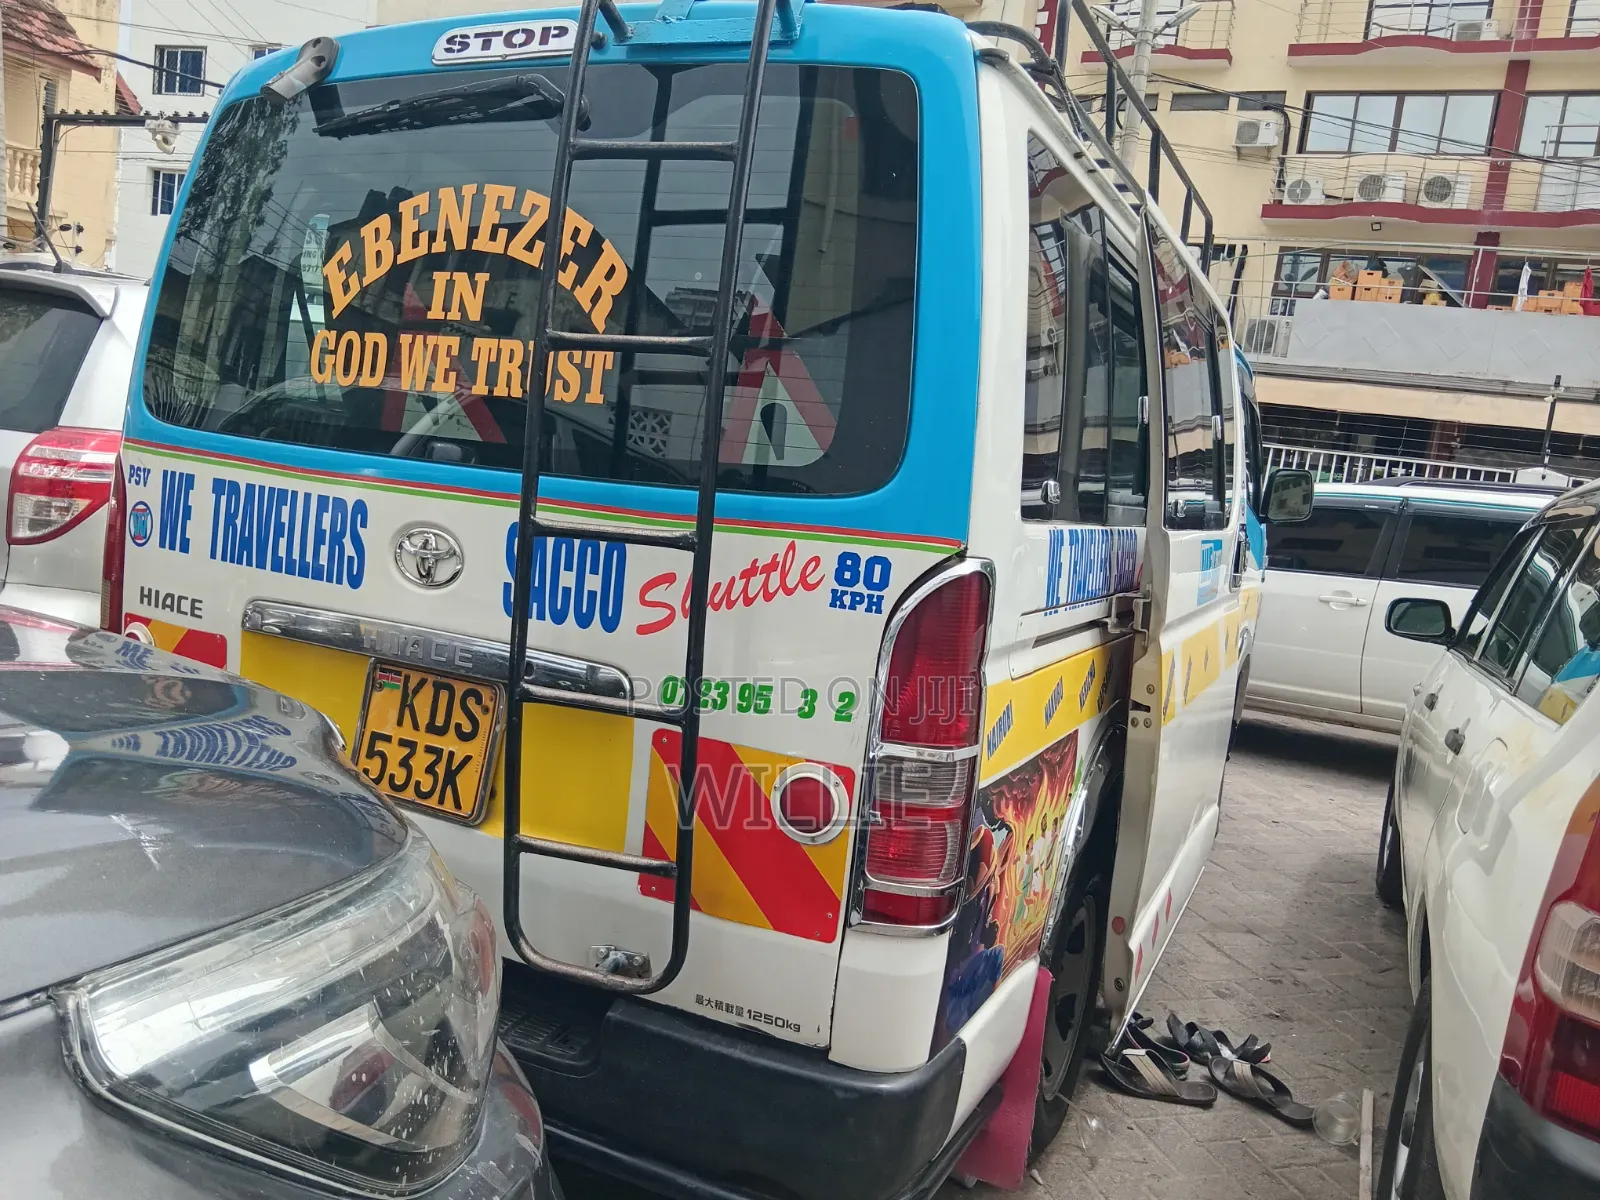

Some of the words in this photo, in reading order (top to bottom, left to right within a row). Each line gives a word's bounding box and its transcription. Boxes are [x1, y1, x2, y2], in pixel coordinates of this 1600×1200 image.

[443, 25, 569, 54] STOP
[322, 183, 628, 334] EBENEZER
[427, 271, 490, 321] IN
[311, 330, 388, 387] GOD
[399, 333, 460, 393] WE
[128, 465, 151, 487] PSV
[159, 470, 195, 554] WE
[210, 478, 368, 590] TRAVELLERS
[834, 551, 892, 592] 80
[1044, 528, 1064, 616] WE
[139, 586, 203, 619] HIACE
[829, 589, 885, 614] KPH
[363, 626, 472, 668] HIACE
[397, 673, 484, 742] KDS
[362, 731, 473, 810] 533K
[695, 993, 745, 1018] 最大積載量
[747, 1008, 801, 1033] 1250kg
